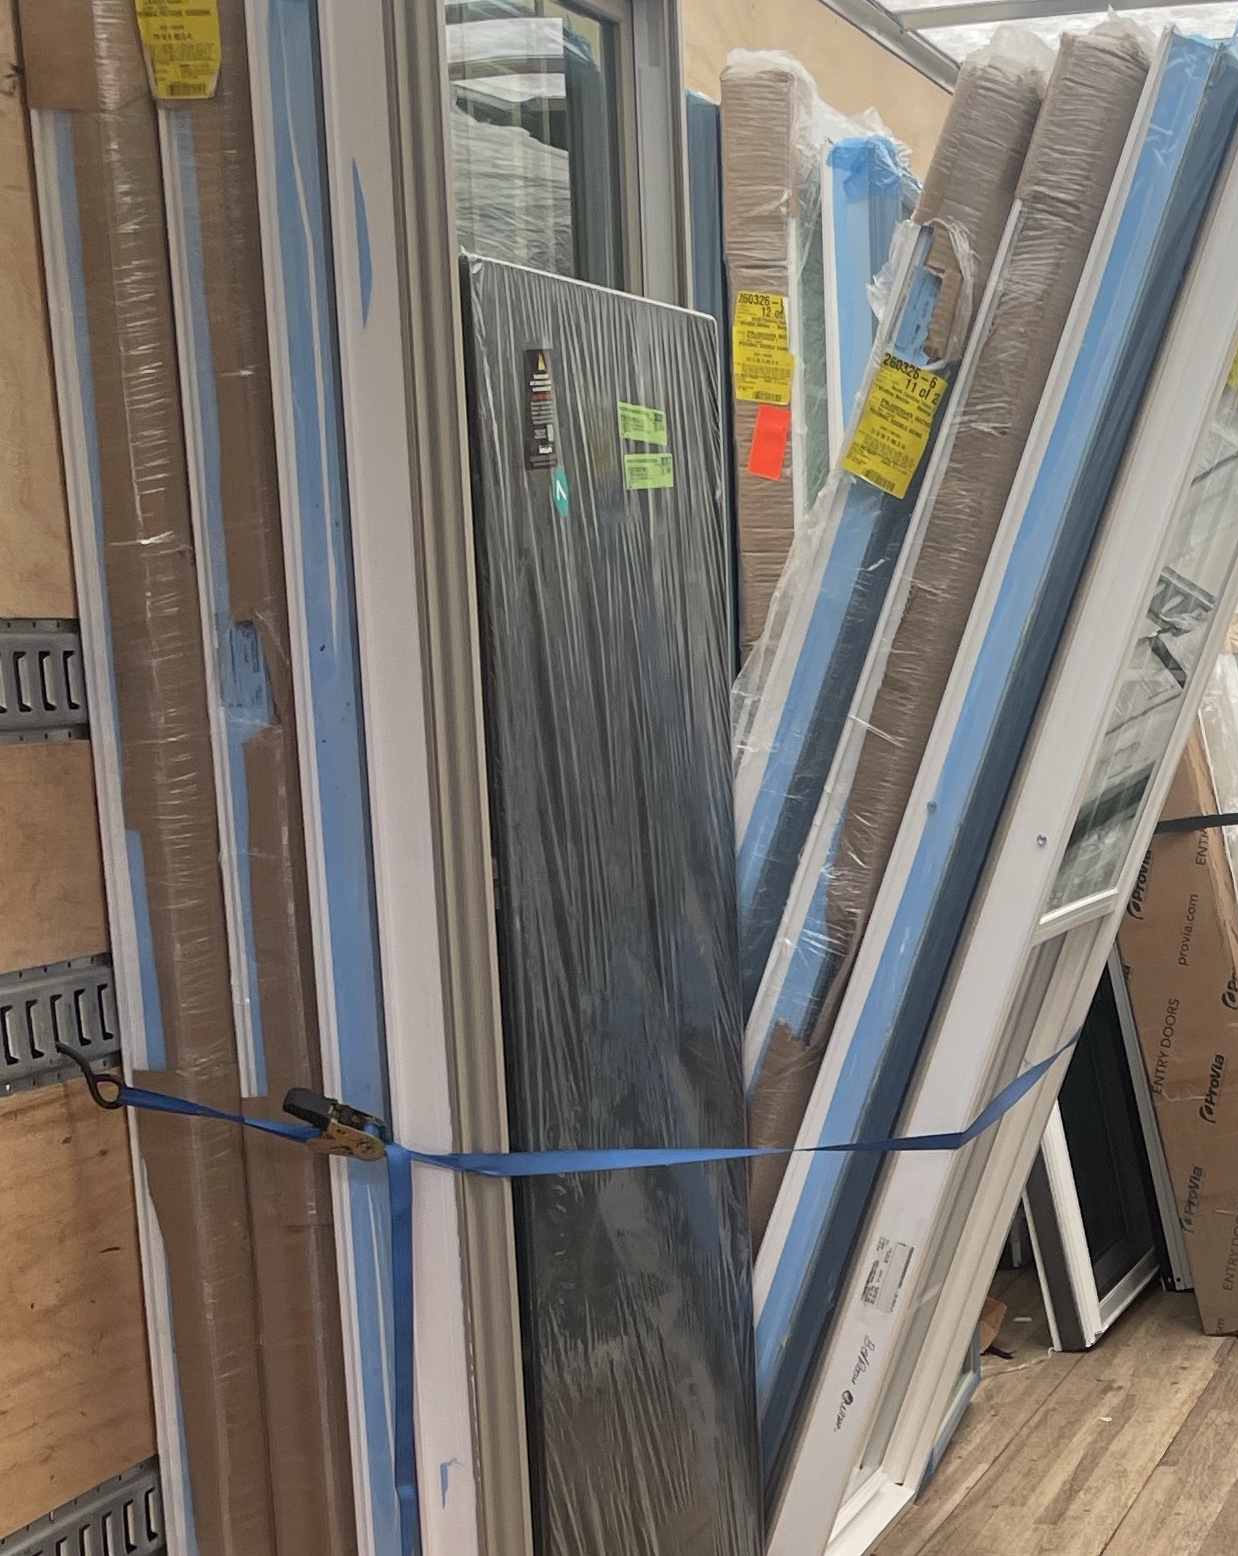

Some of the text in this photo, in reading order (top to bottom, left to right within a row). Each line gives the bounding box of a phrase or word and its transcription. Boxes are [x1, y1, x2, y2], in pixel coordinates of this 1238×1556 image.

[738, 292, 784, 308] 260326-
[904, 379, 918, 394] 11
[918, 387, 931, 401] of
[1178, 894, 1199, 967] provia.com
[1152, 998, 1180, 1095] ENTRY DOORS
[1205, 1053, 1225, 1107] ProVia
[1184, 1165, 1204, 1219] ProVia
